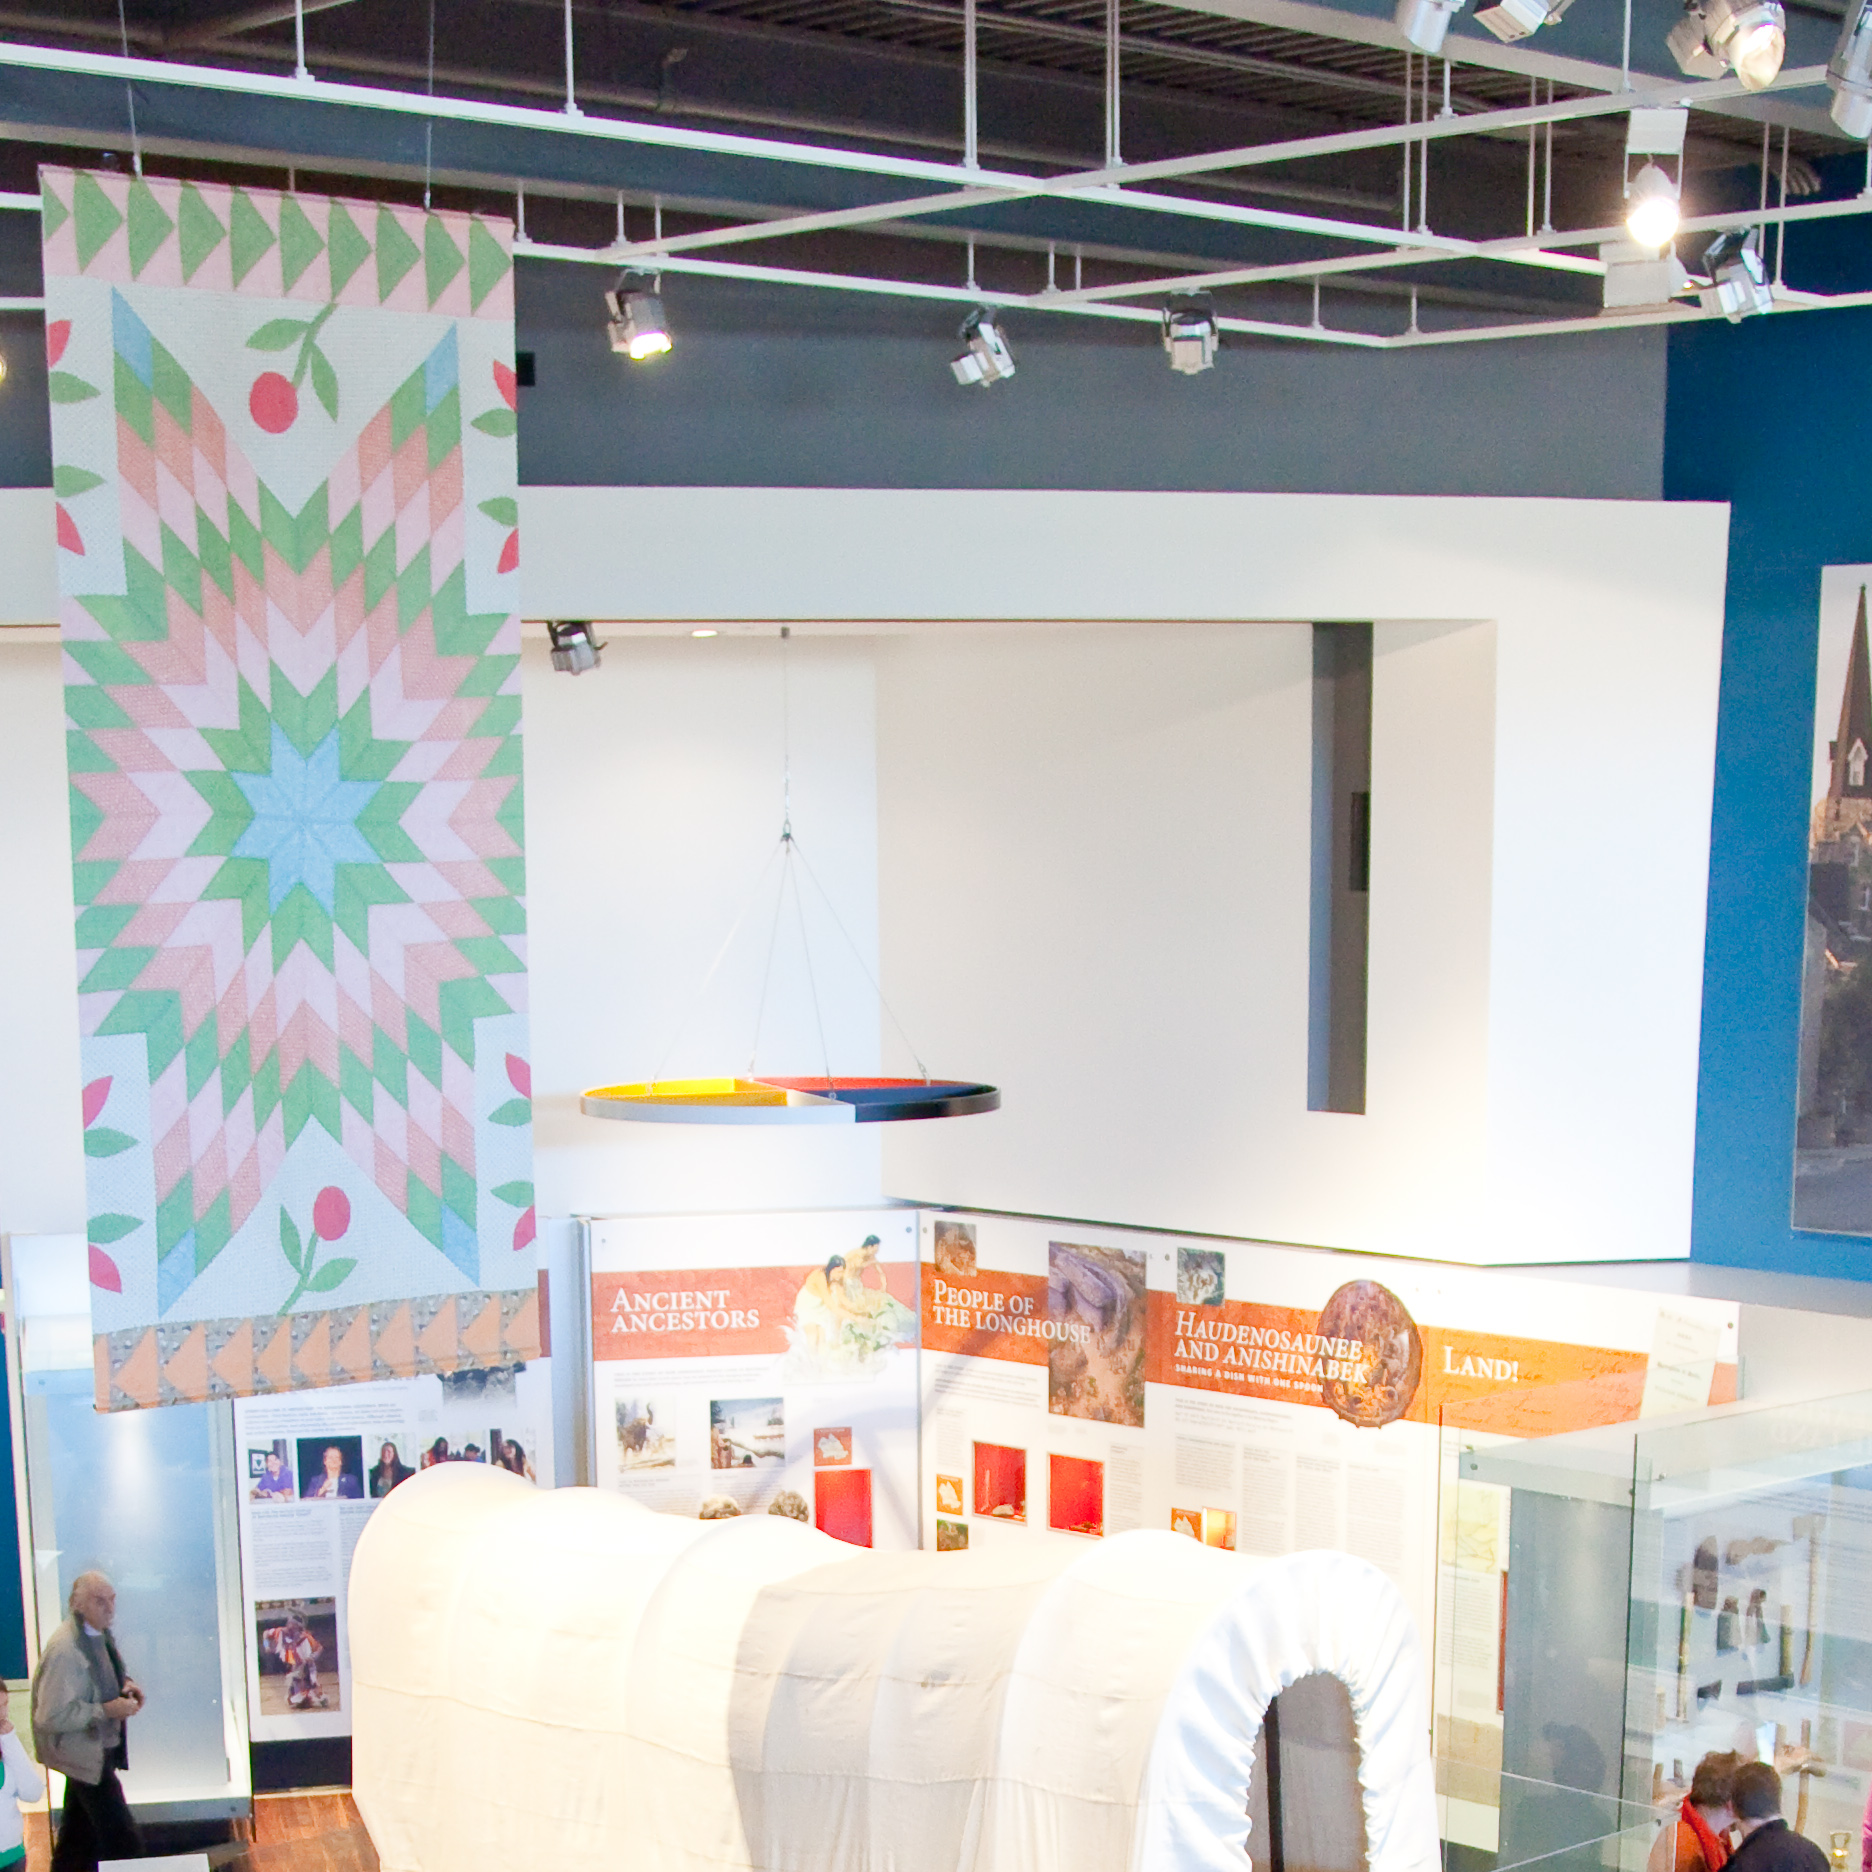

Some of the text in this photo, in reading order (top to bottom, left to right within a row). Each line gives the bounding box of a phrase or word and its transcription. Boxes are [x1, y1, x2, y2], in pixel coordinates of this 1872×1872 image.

[610, 1287, 731, 1314] ANCIENT
[933, 1279, 1034, 1315] PEOPLE OF
[611, 1308, 761, 1334] ANCESTORS
[933, 1305, 1091, 1345] THE LONGHOUSE
[1175, 1311, 1365, 1361] HAUDENOSAUNEE
[1174, 1338, 1369, 1385] AND ANISHINABEK
[1175, 1363, 1324, 1393] SHARING A DISH WITH ONE SPOON
[1443, 1345, 1520, 1383] LAND!
